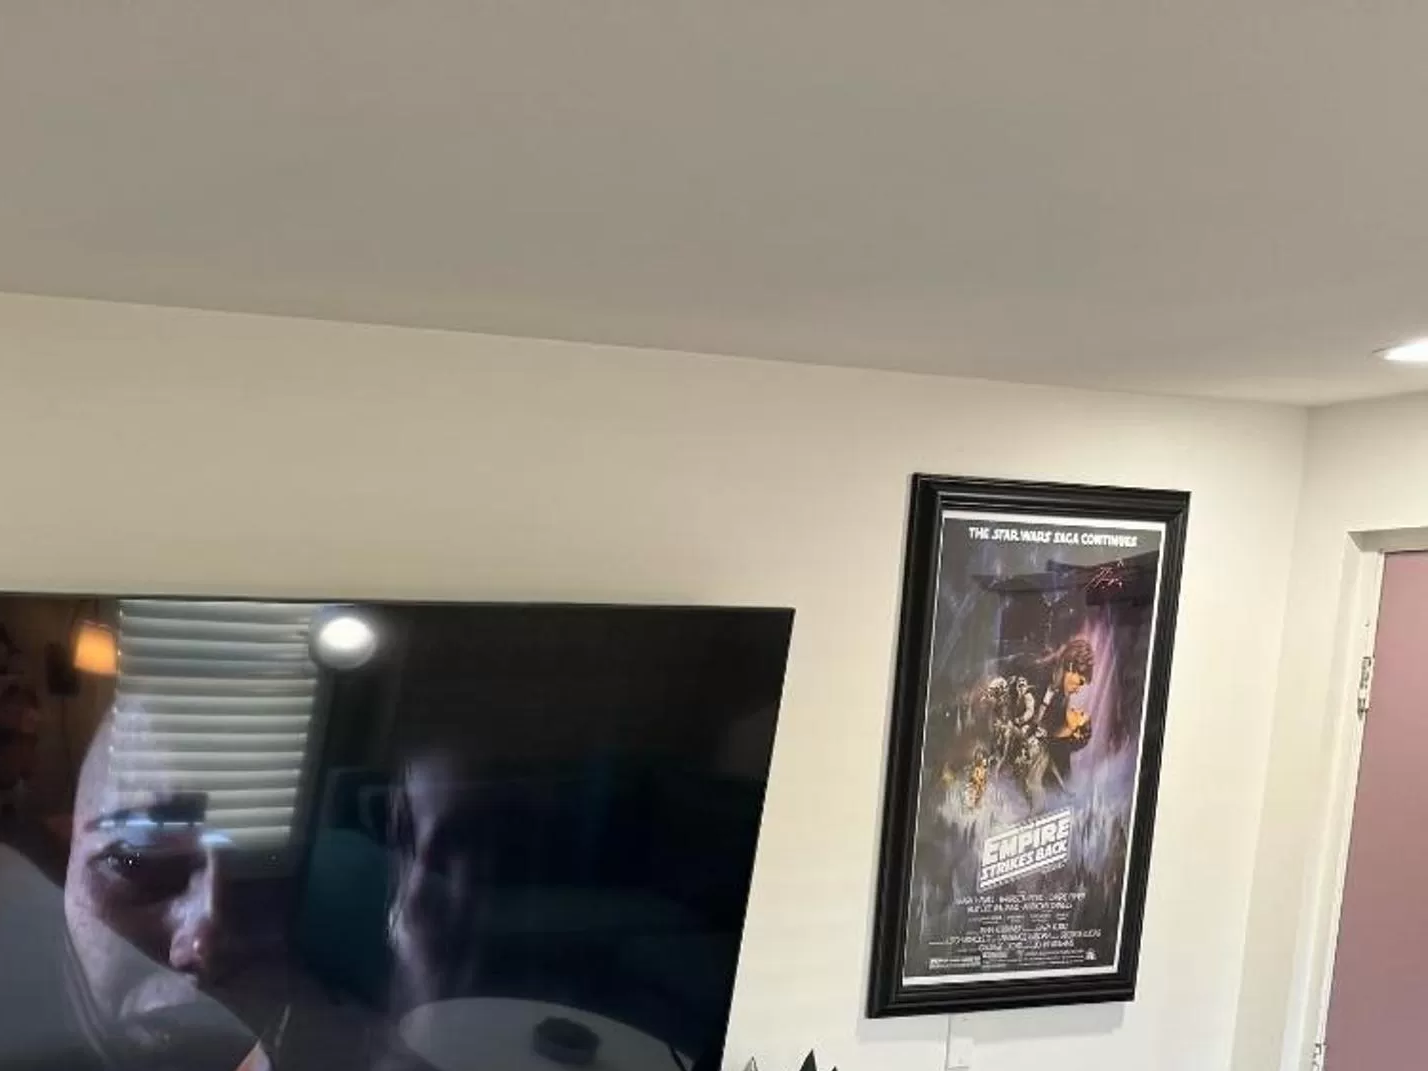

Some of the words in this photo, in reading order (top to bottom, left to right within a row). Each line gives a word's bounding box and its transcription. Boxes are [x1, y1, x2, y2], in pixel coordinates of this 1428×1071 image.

[969, 527, 990, 540] THE
[992, 528, 1019, 542] STAR
[1021, 530, 1052, 544] WARS
[1053, 532, 1079, 545] SAGA
[1081, 533, 1138, 547] CONTINUES
[980, 850, 1034, 881] STRIKES
[1035, 840, 1068, 861] BACK
[982, 820, 1070, 868] EMPIRE
